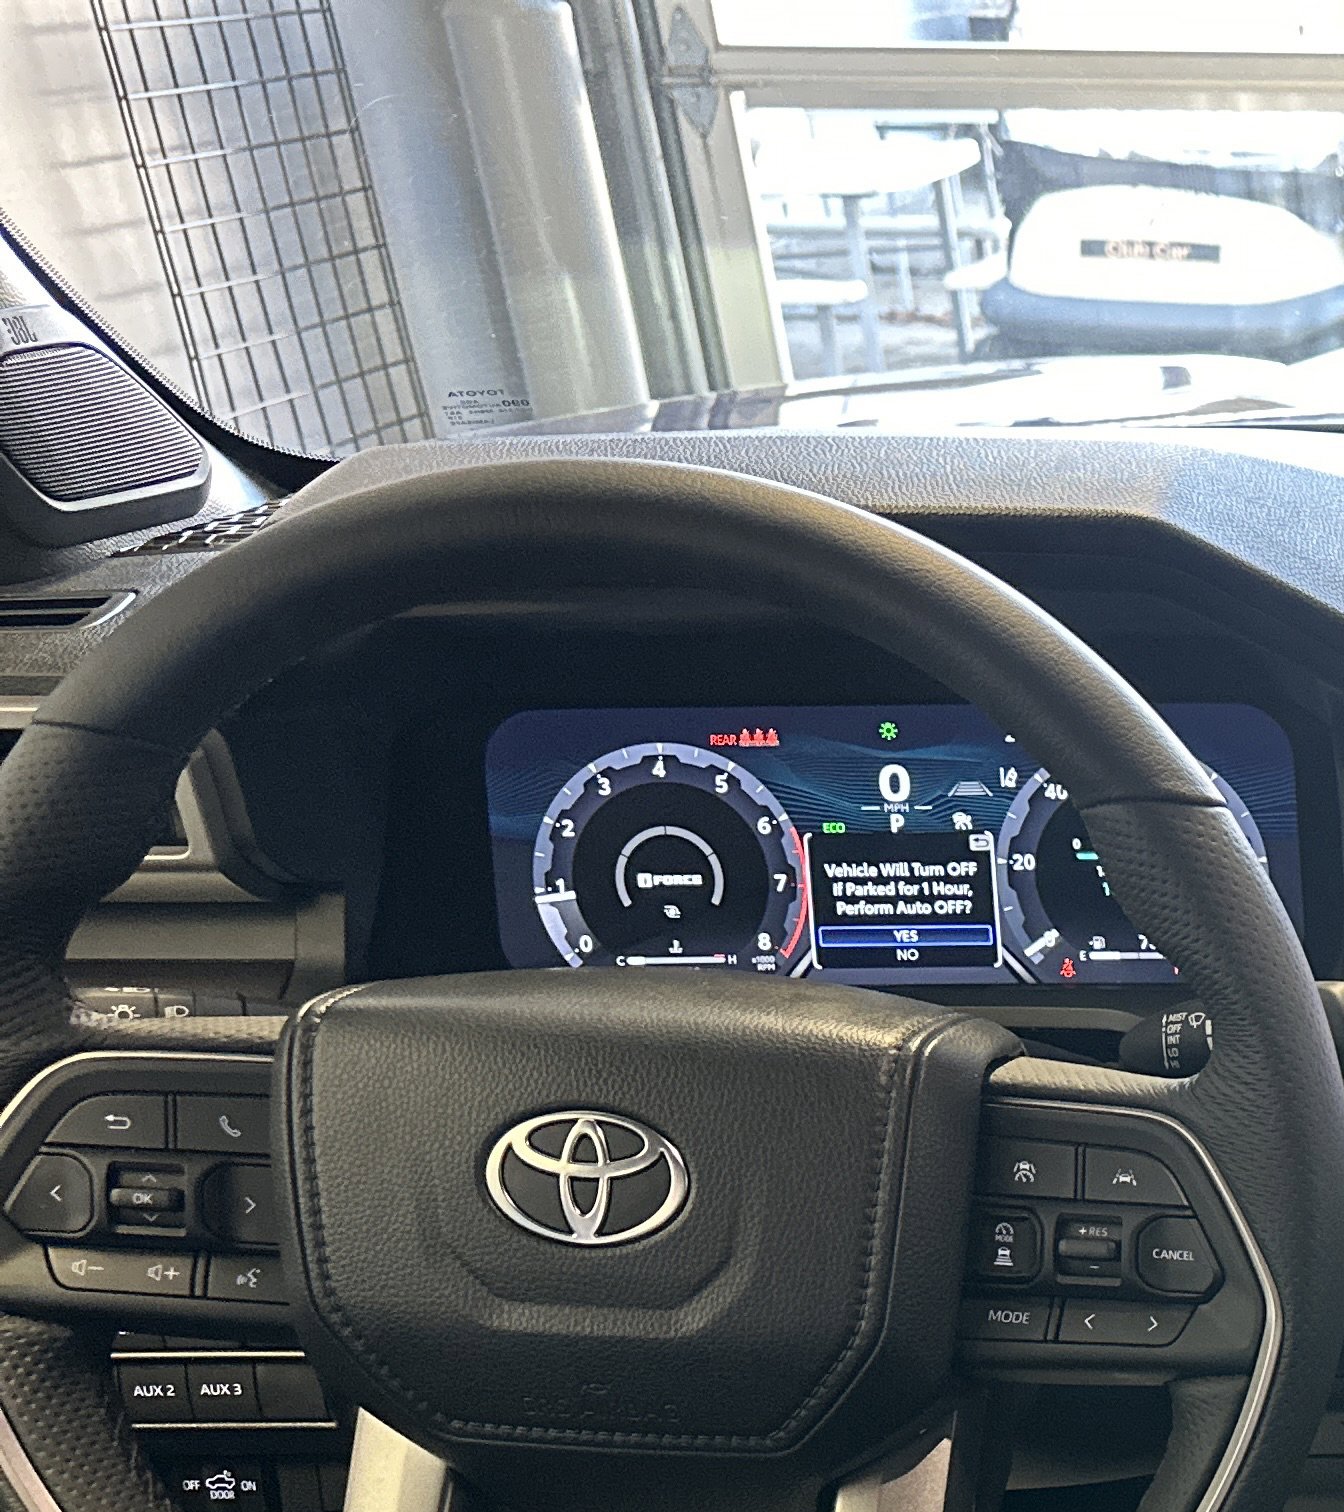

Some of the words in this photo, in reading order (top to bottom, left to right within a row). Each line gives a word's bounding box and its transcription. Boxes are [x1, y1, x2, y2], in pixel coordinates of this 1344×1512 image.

[1, 315, 39, 346] JBL
[709, 734, 737, 746] REAR
[652, 759, 667, 778] 4
[598, 777, 612, 796] 3
[714, 775, 728, 794] 5
[878, 763, 911, 802] 0
[883, 803, 910, 813] MPH
[560, 818, 576, 837] 2
[756, 816, 772, 835] 6
[822, 822, 846, 834] ECO
[889, 813, 905, 834] P
[823, 862, 878, 877] Vehicle
[879, 862, 910, 877] Will
[911, 862, 945, 877] Turn
[946, 861, 978, 876] OFF
[1012, 853, 1036, 871] 20
[773, 874, 788, 892] 7
[832, 882, 844, 897] If
[845, 881, 896, 897] Parked
[898, 881, 920, 896] for
[921, 882, 930, 896] 1
[932, 881, 973, 898] Hour,
[836, 901, 894, 916] Perform
[896, 901, 933, 915] Auto
[934, 900, 973, 915] OFF?
[757, 932, 772, 951] 8
[893, 930, 919, 943] YES
[578, 935, 593, 953] 0
[616, 955, 626, 966] C
[728, 955, 738, 965] H
[896, 949, 919, 961] NO
[1166, 1023, 1182, 1034] OFF
[1167, 1034, 1180, 1045] INT
[132, 1192, 153, 1205] OK
[1152, 1248, 1195, 1261] CANCEL
[987, 1309, 1031, 1325] MODE
[133, 1384, 164, 1397] AUX
[166, 1384, 176, 1397] 2
[200, 1383, 231, 1396] AUX
[234, 1383, 242, 1396] 3
[182, 1480, 200, 1491] OFF
[240, 1481, 257, 1491] ON
[209, 1490, 236, 1500] DOOR
